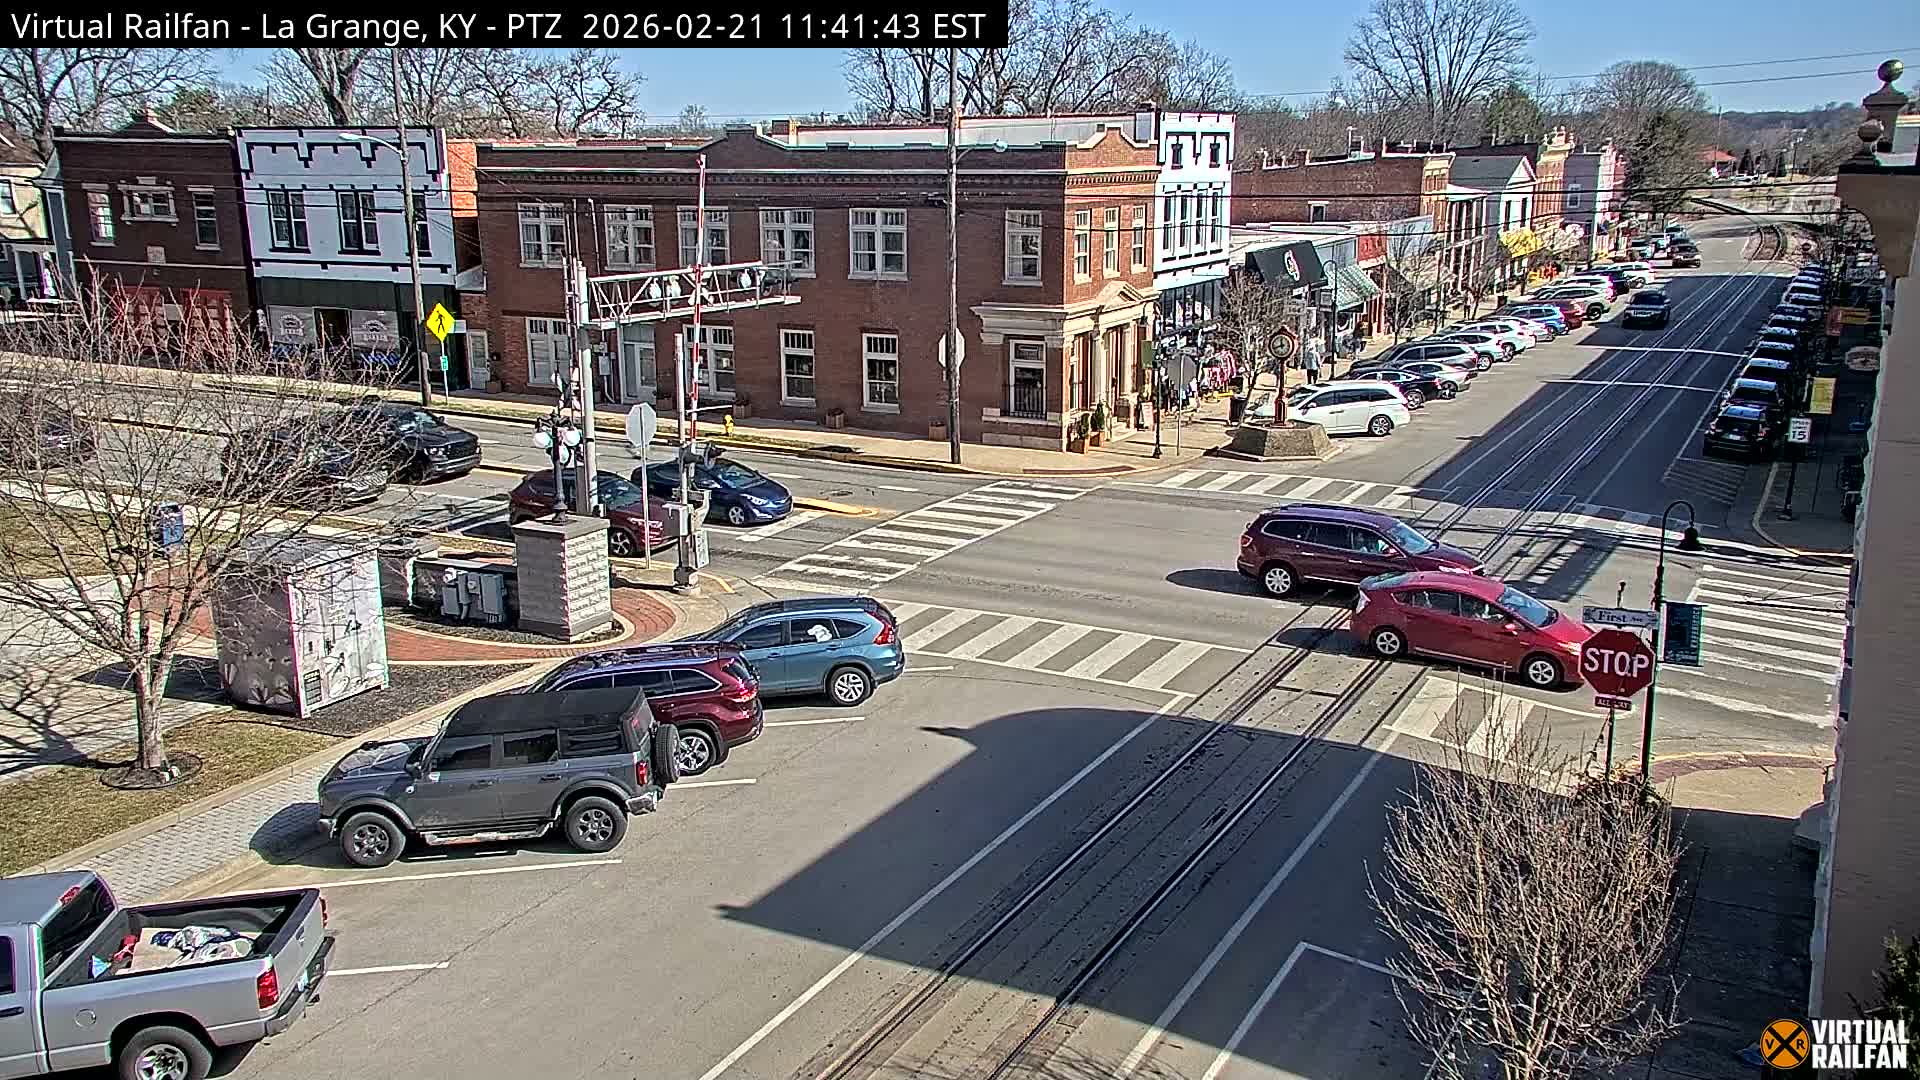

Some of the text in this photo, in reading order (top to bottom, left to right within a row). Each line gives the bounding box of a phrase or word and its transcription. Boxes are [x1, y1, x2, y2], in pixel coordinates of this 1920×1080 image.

[1791, 430, 1807, 440] 15
[1598, 610, 1627, 623] First
[1583, 647, 1650, 678] STOP
[1597, 698, 1611, 707] ALL
